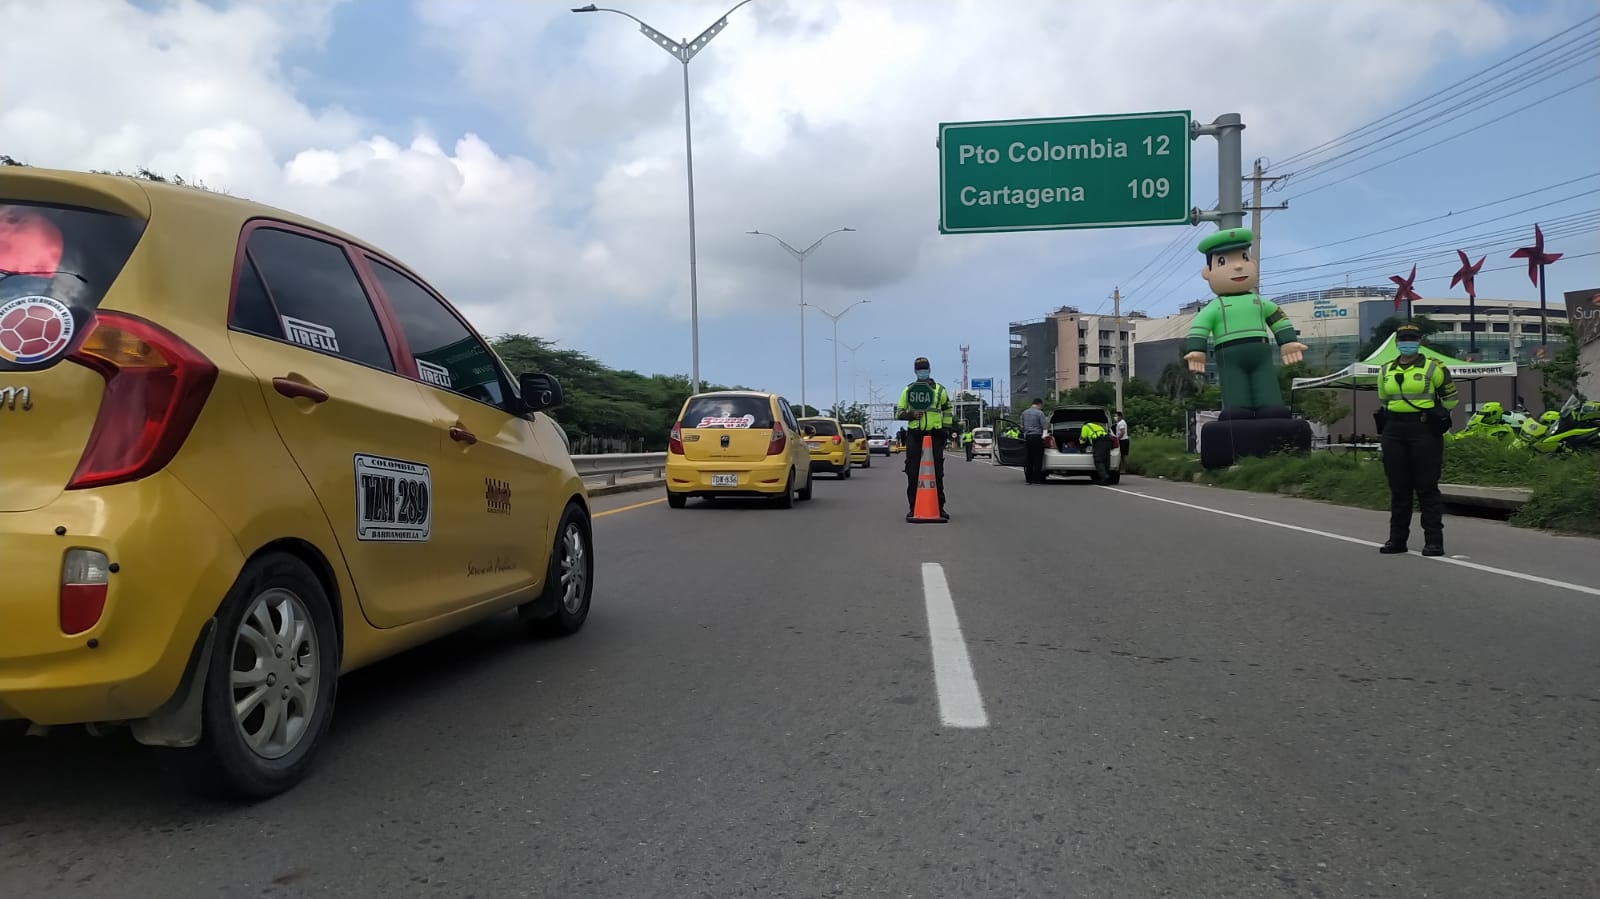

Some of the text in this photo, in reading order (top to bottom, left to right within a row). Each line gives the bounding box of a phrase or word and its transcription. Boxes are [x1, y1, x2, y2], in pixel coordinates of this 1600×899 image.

[959, 135, 1170, 164] Pto Colombia 12
[960, 178, 1170, 209] Cartagena 109
[281, 314, 340, 353] PIRELLI
[415, 358, 452, 388] PIRELLI
[1459, 366, 1504, 374] TRANSPORTE
[909, 391, 931, 403] SIGA
[371, 459, 416, 471] COLOMBIA
[371, 530, 419, 539] BARRANQUILLA
